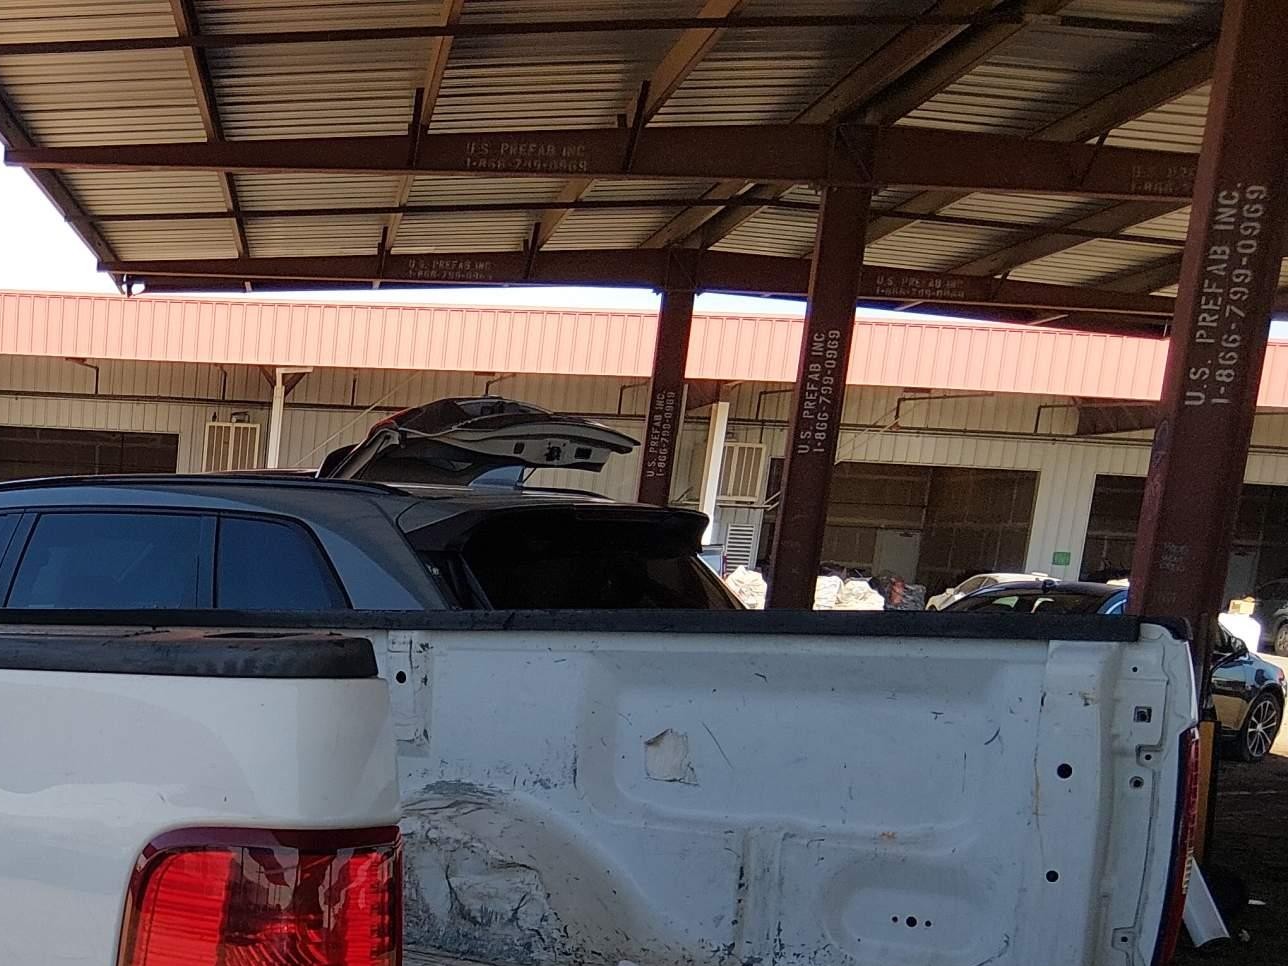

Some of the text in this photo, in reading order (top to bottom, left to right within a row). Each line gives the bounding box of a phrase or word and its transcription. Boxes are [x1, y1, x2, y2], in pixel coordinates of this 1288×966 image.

[1184, 182, 1242, 406] U.S. PREFAB INC.
[1211, 185, 1268, 404] 1-866-799-0969
[649, 414, 663, 453] PREFAB
[803, 363, 822, 418] PREFAB
[813, 330, 840, 453] 1-866-799-0969
[798, 426, 813, 454] U.S.
